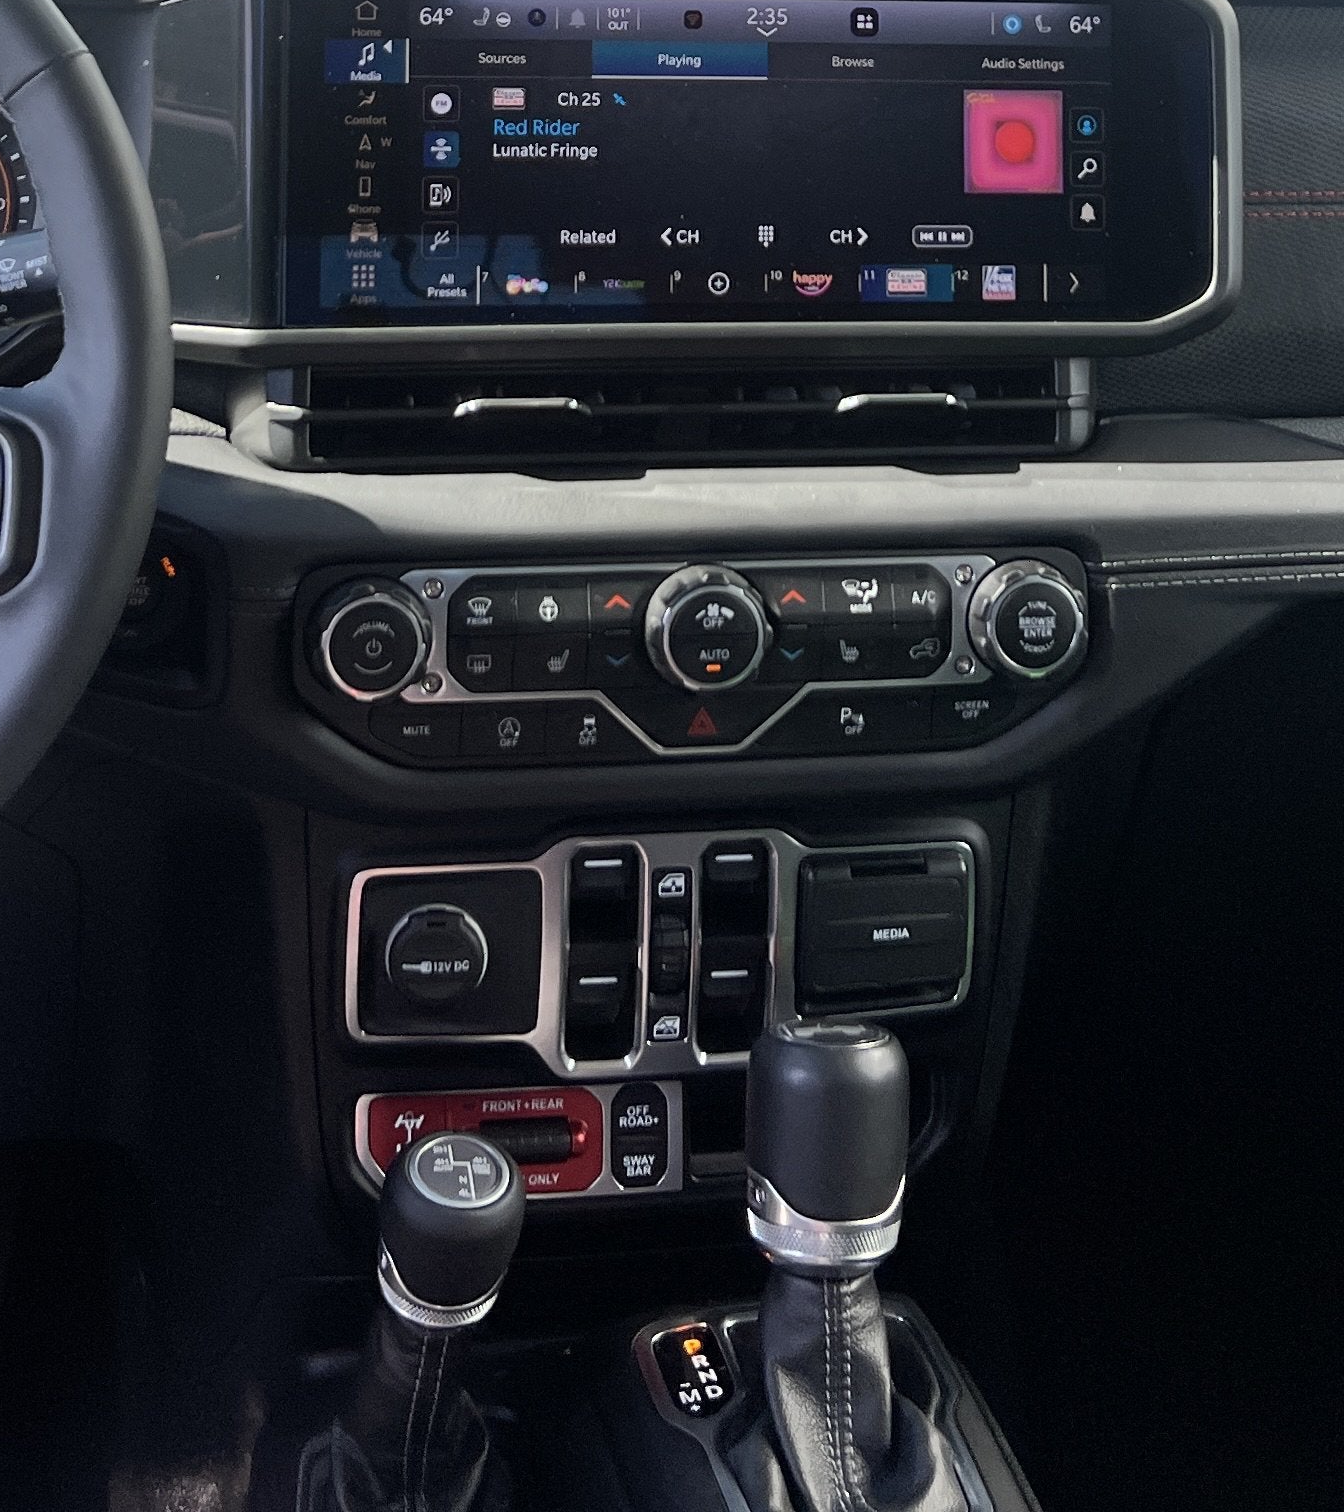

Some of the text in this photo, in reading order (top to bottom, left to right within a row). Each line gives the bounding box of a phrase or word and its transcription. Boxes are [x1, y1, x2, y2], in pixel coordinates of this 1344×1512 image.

[747, 8, 788, 25] 2:35
[607, 21, 629, 30] OUT
[351, 28, 382, 37] Home
[478, 53, 527, 65] Sources
[658, 54, 702, 68] Playing
[831, 56, 875, 68] Browse
[981, 58, 1065, 72] Audio Settings
[350, 71, 382, 81] Media
[557, 92, 601, 107] Ch 25
[344, 114, 387, 126] Comfort
[493, 119, 580, 136] Red Rider
[492, 143, 598, 161] Lunatic Fringe
[356, 159, 376, 170] Nav
[347, 203, 382, 215] Phone
[560, 229, 616, 245] Related
[676, 229, 700, 244] CH
[829, 229, 853, 244] CH
[346, 248, 383, 259] Vehicle
[26, 255, 48, 269] MIST
[439, 273, 455, 285] All
[481, 271, 490, 283] 7
[673, 271, 682, 282] 9
[770, 270, 783, 281] 10
[792, 270, 834, 286] happy
[864, 270, 876, 281] 11
[956, 270, 969, 281] 12
[427, 287, 468, 299] Presets
[351, 294, 377, 306] Apps
[911, 589, 937, 605] A/C
[466, 616, 494, 626] FRONT
[703, 617, 725, 629] OFF
[1018, 616, 1056, 626] BROWSE
[1023, 627, 1053, 638] ENTER
[699, 648, 731, 661] AUTO
[954, 700, 990, 711] SCREEN
[403, 725, 431, 736] MUTE
[499, 738, 519, 748] OFF
[578, 736, 597, 747] OFF
[872, 926, 910, 941] MEDIA
[433, 959, 470, 974] 12V DC
[626, 1104, 651, 1118] OFF
[623, 1154, 656, 1169] SWAY
[626, 1164, 653, 1178] BAR
[458, 1174, 468, 1185] N
[528, 1172, 561, 1187] ONLY
[691, 1354, 710, 1369] R
[697, 1368, 718, 1384] N
[678, 1388, 702, 1405] M
[704, 1384, 724, 1400] D
